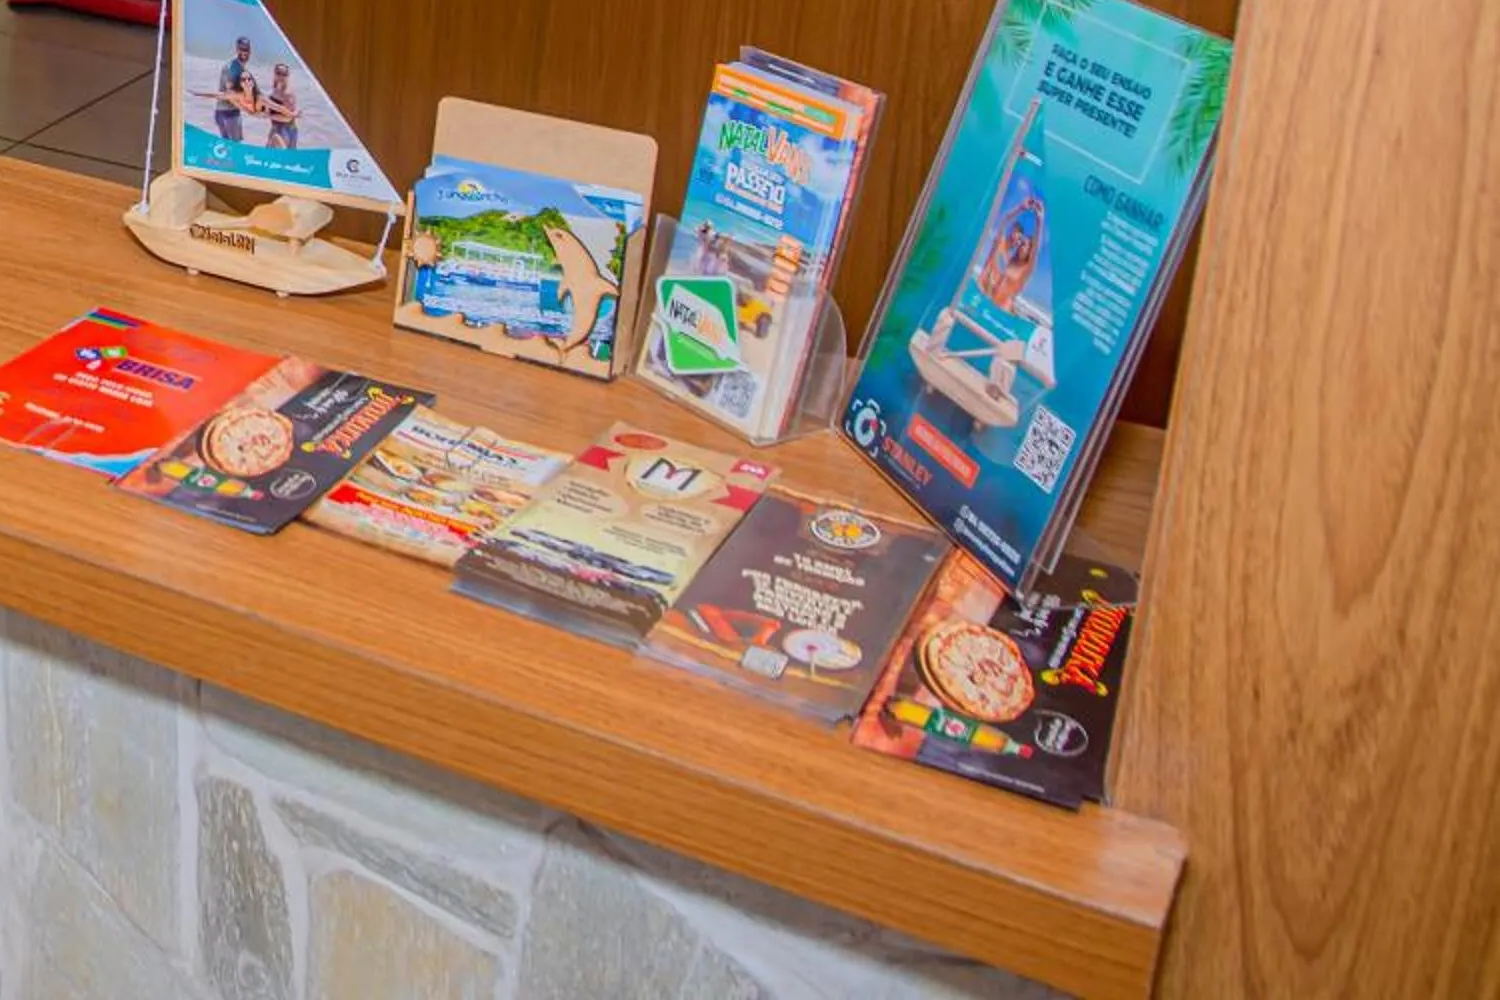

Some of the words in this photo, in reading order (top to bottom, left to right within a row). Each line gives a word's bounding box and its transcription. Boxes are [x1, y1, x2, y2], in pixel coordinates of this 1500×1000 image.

[1079, 57, 1090, 71] O
[1044, 60, 1057, 78] E
[1106, 90, 1146, 122] ESSE
[116, 359, 195, 390] BRISA
